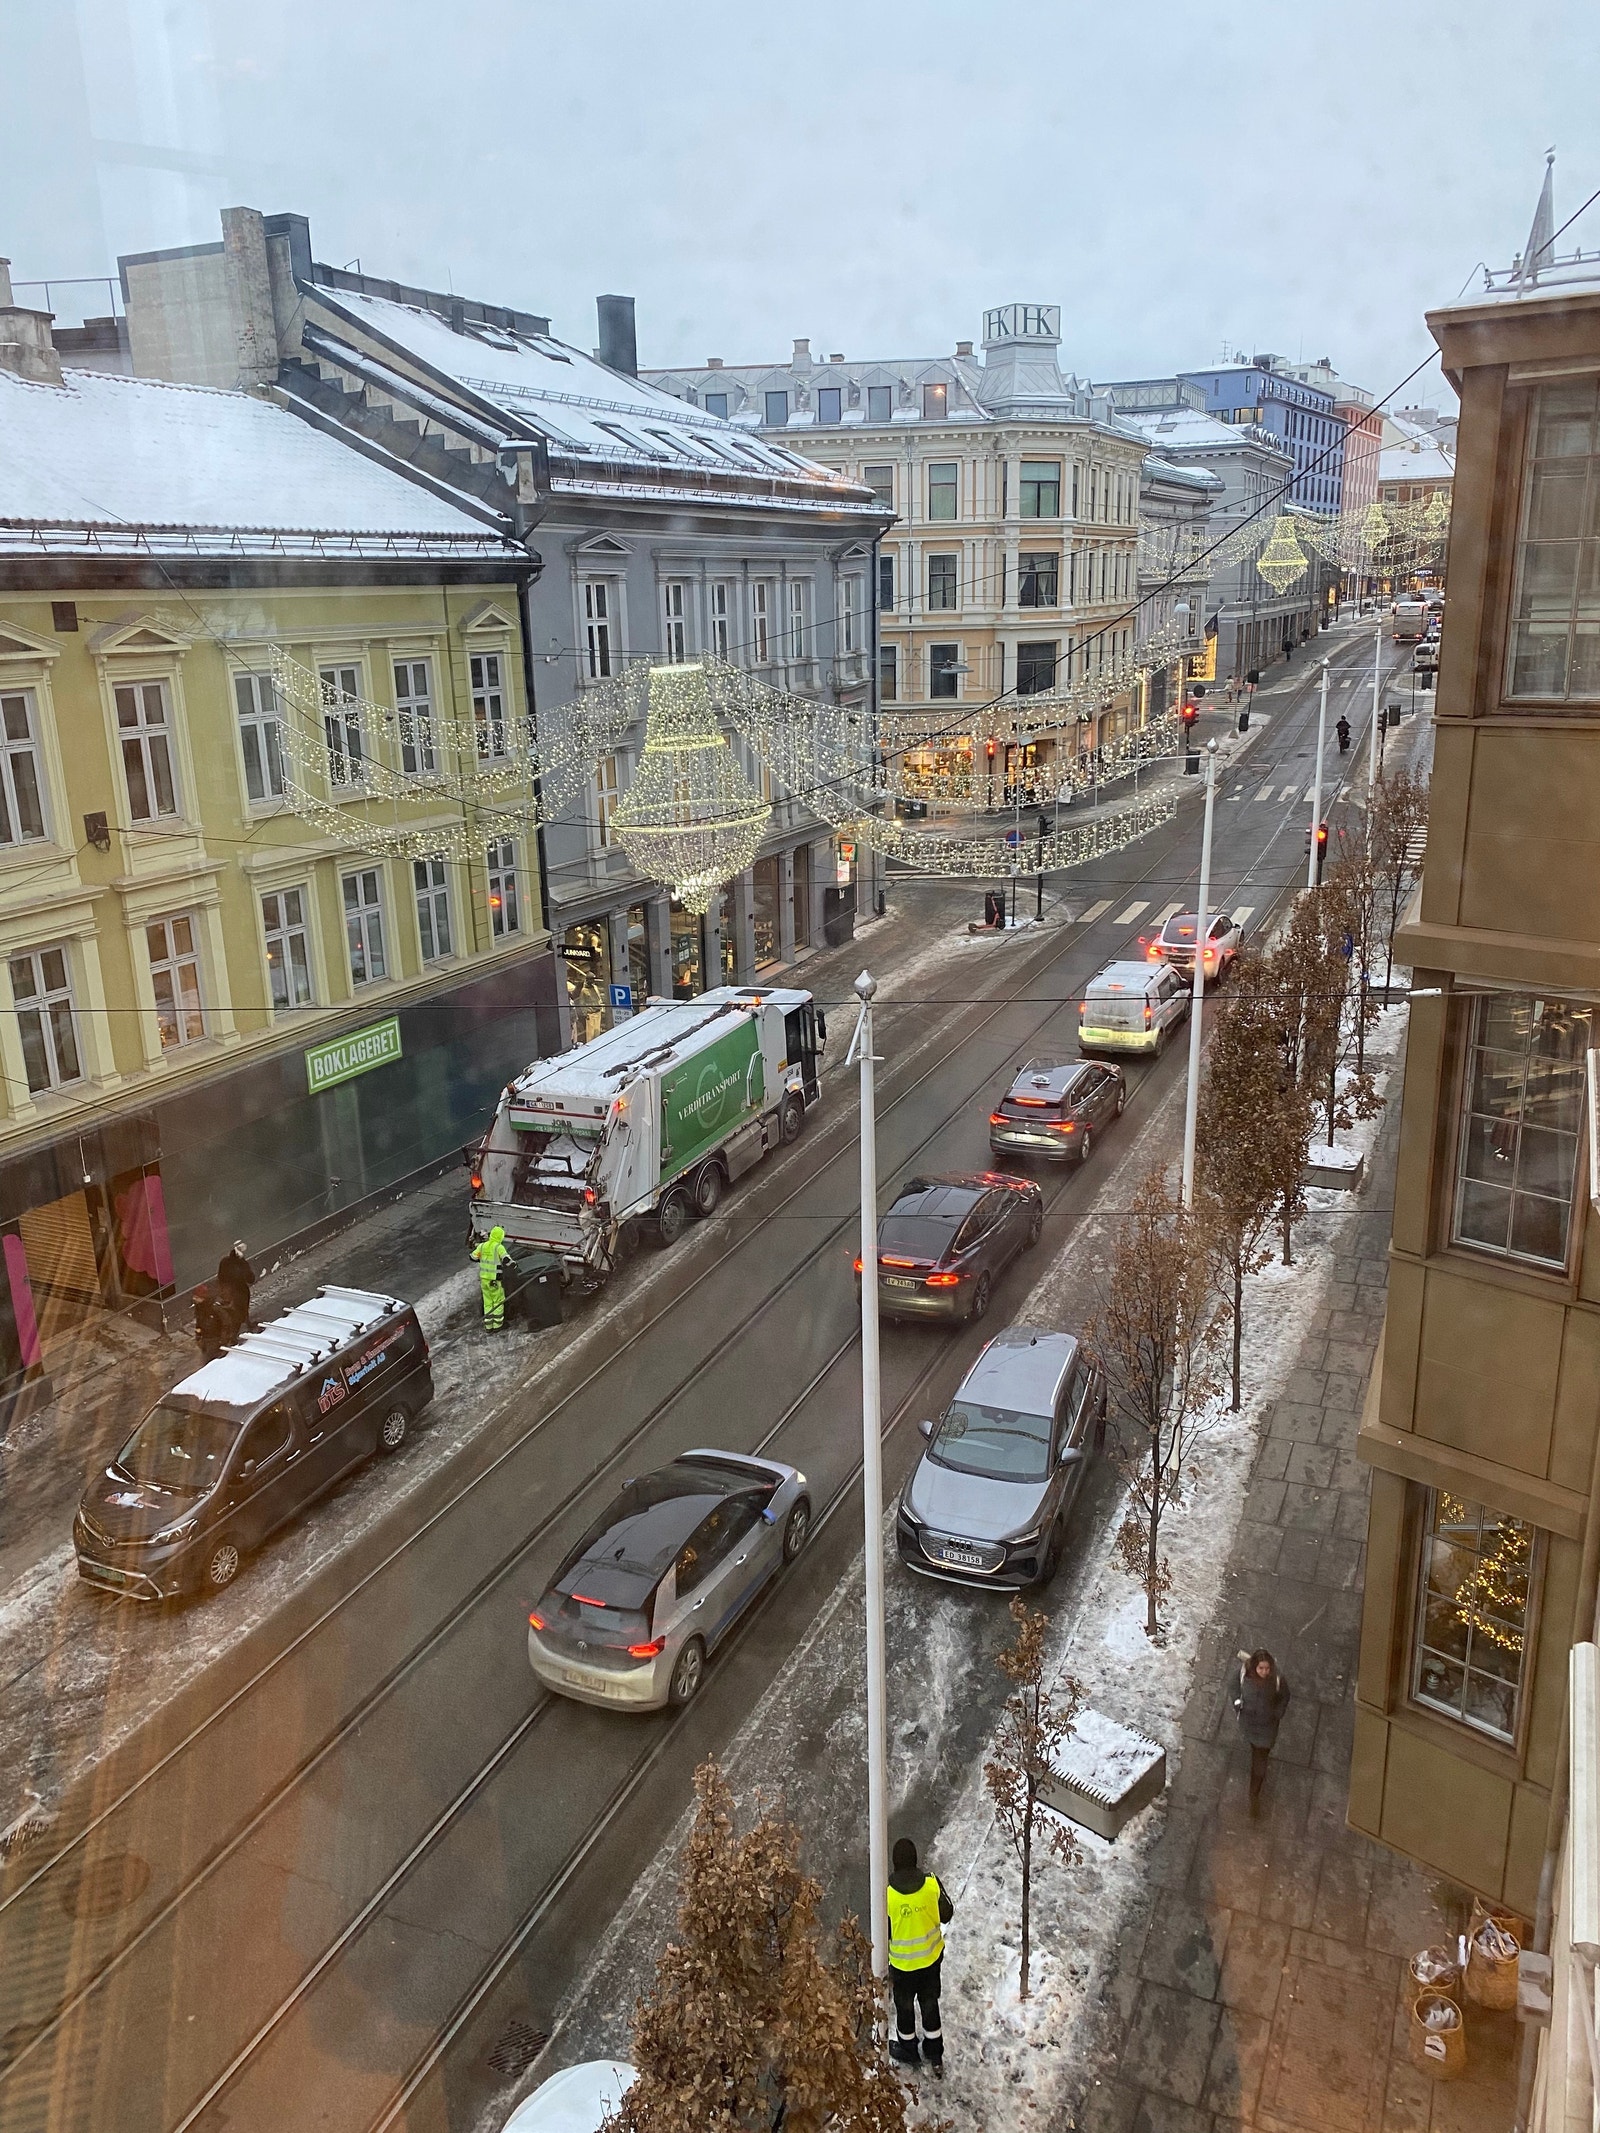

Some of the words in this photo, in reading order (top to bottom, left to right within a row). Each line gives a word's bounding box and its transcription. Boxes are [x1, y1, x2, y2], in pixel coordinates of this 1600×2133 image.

[1022, 307, 1054, 335] HK
[614, 988, 626, 1005] P
[313, 1029, 394, 1080] BOKLAGERET
[318, 1382, 346, 1413] BTS
